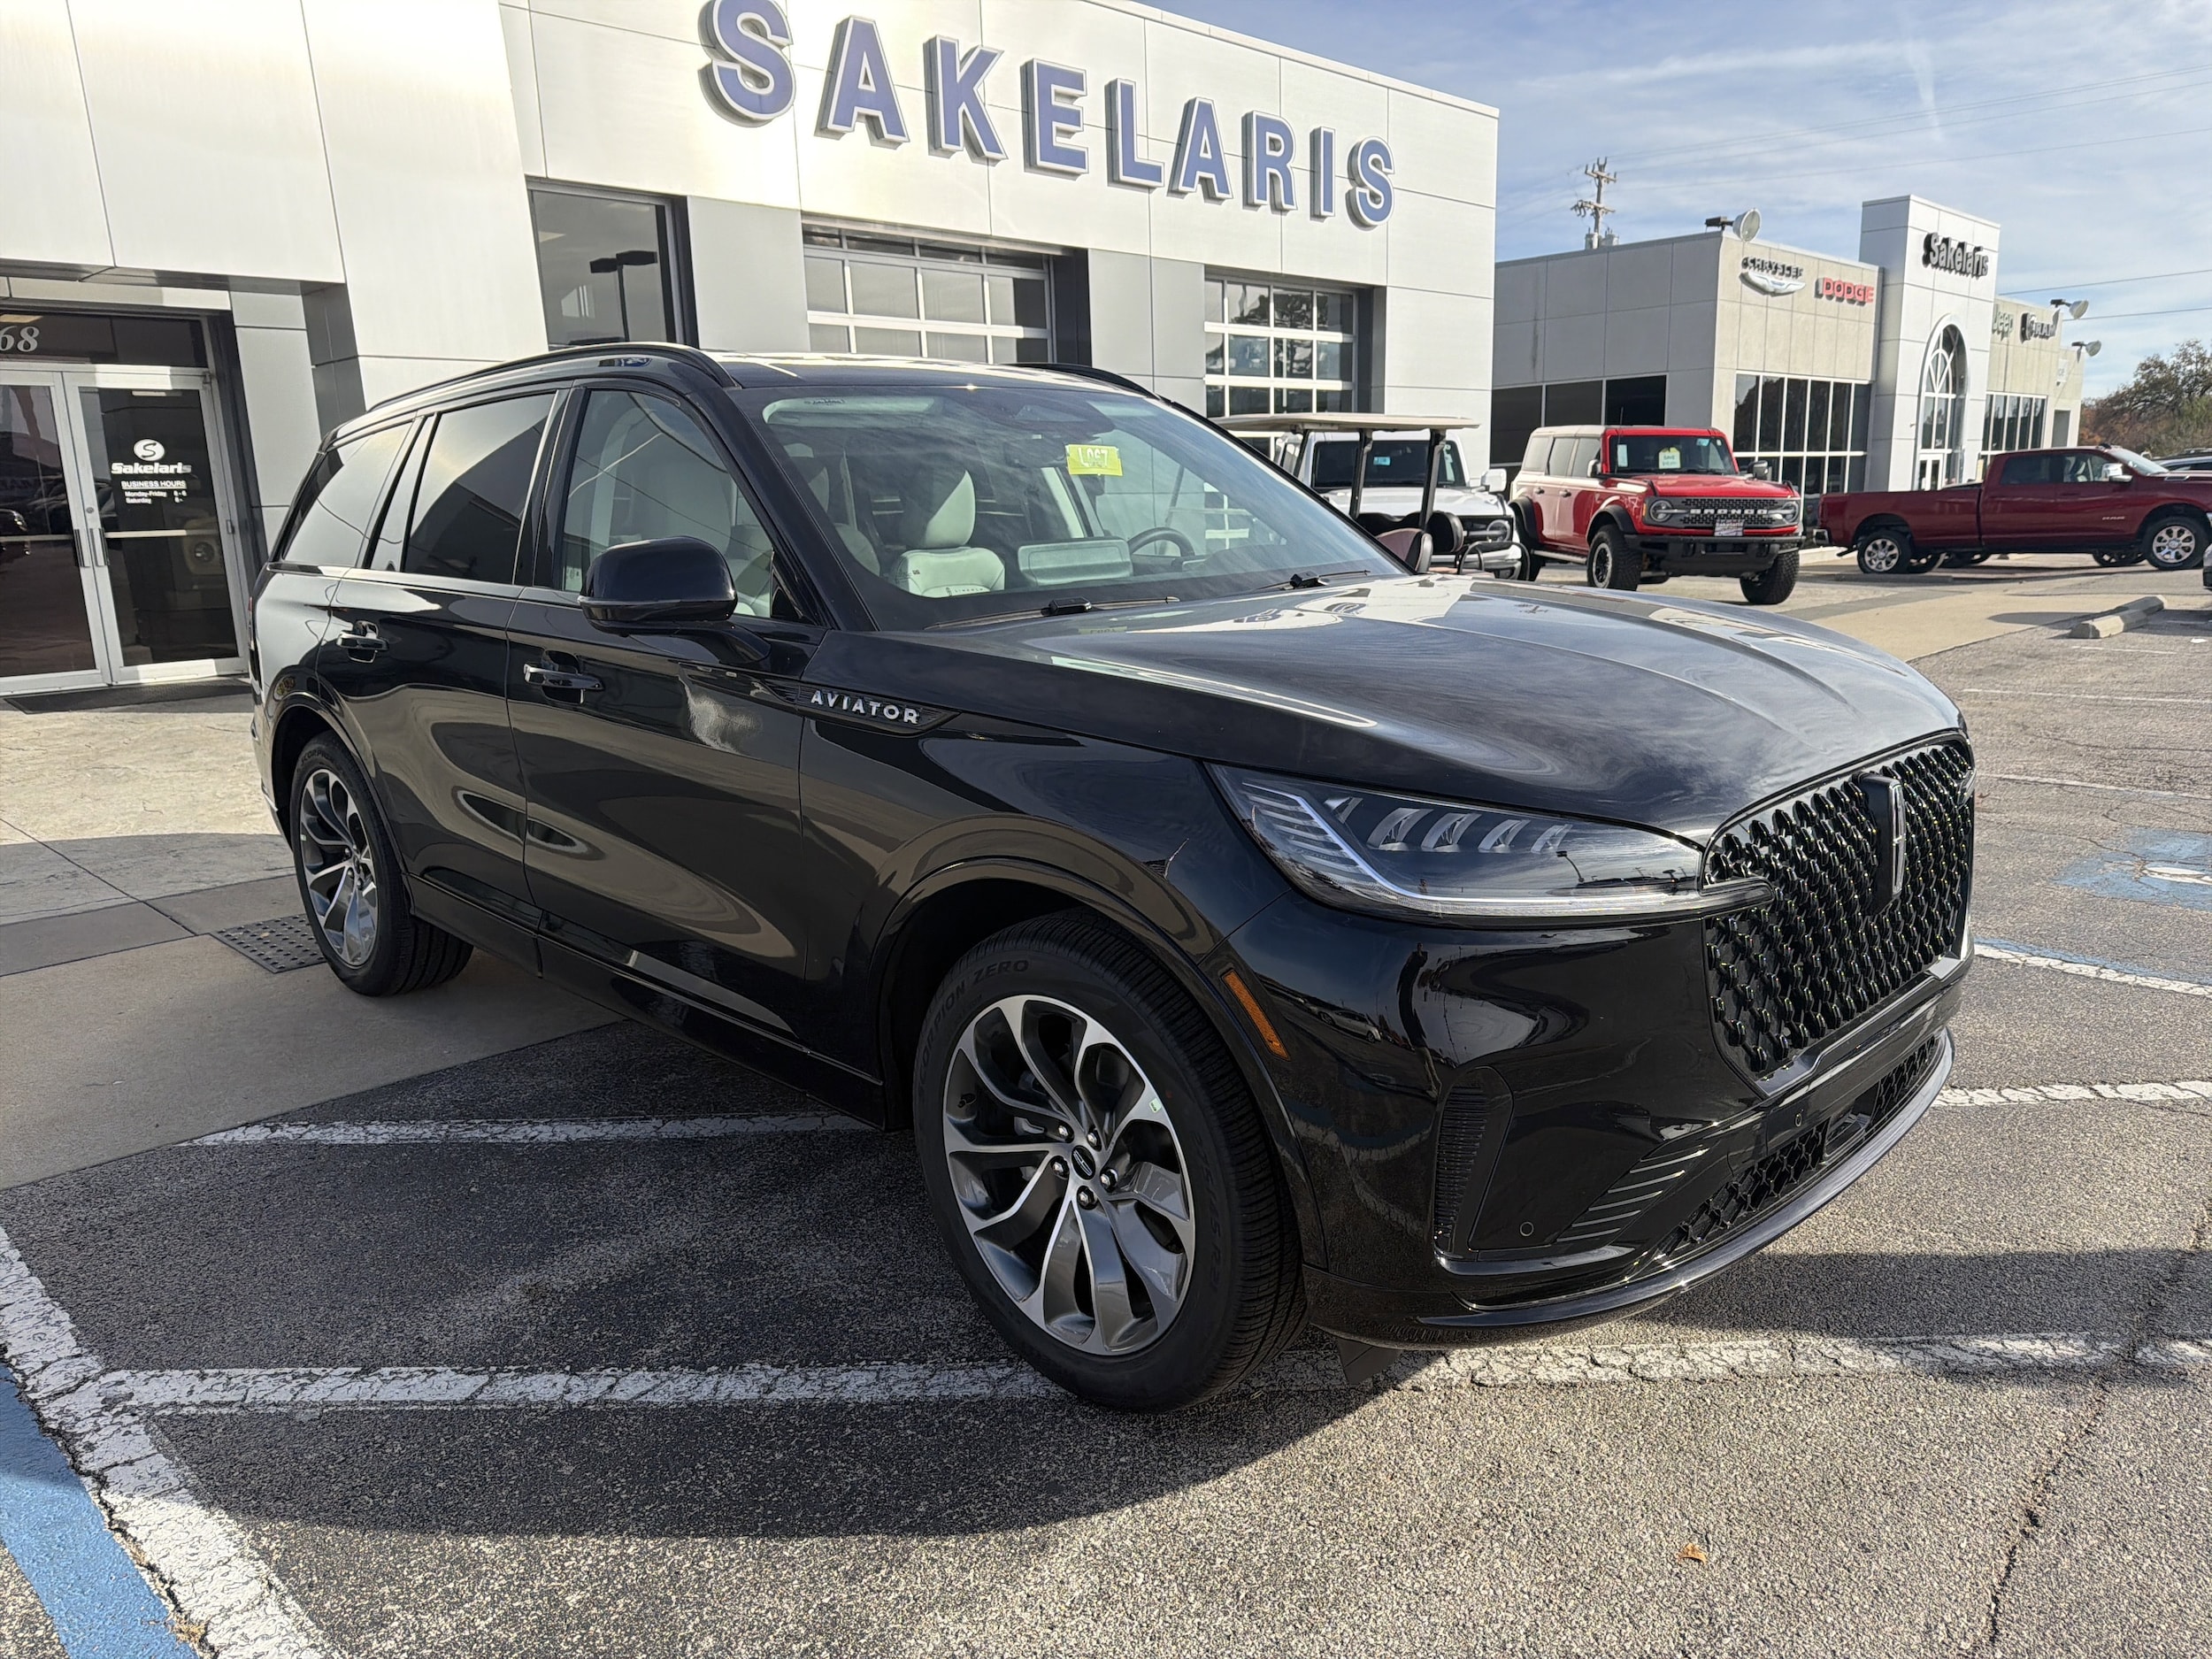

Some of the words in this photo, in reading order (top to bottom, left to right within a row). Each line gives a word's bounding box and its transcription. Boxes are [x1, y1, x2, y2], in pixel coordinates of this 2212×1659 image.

[702, 0, 1395, 227] SAKELARIS
[1925, 232, 1989, 278] Sakelaris
[1820, 277, 1874, 303] DODGE
[0, 326, 40, 352] 68
[111, 462, 192, 474] Sakelaris
[810, 690, 919, 724] AVIATOR
[972, 959, 1030, 985] ZERO
